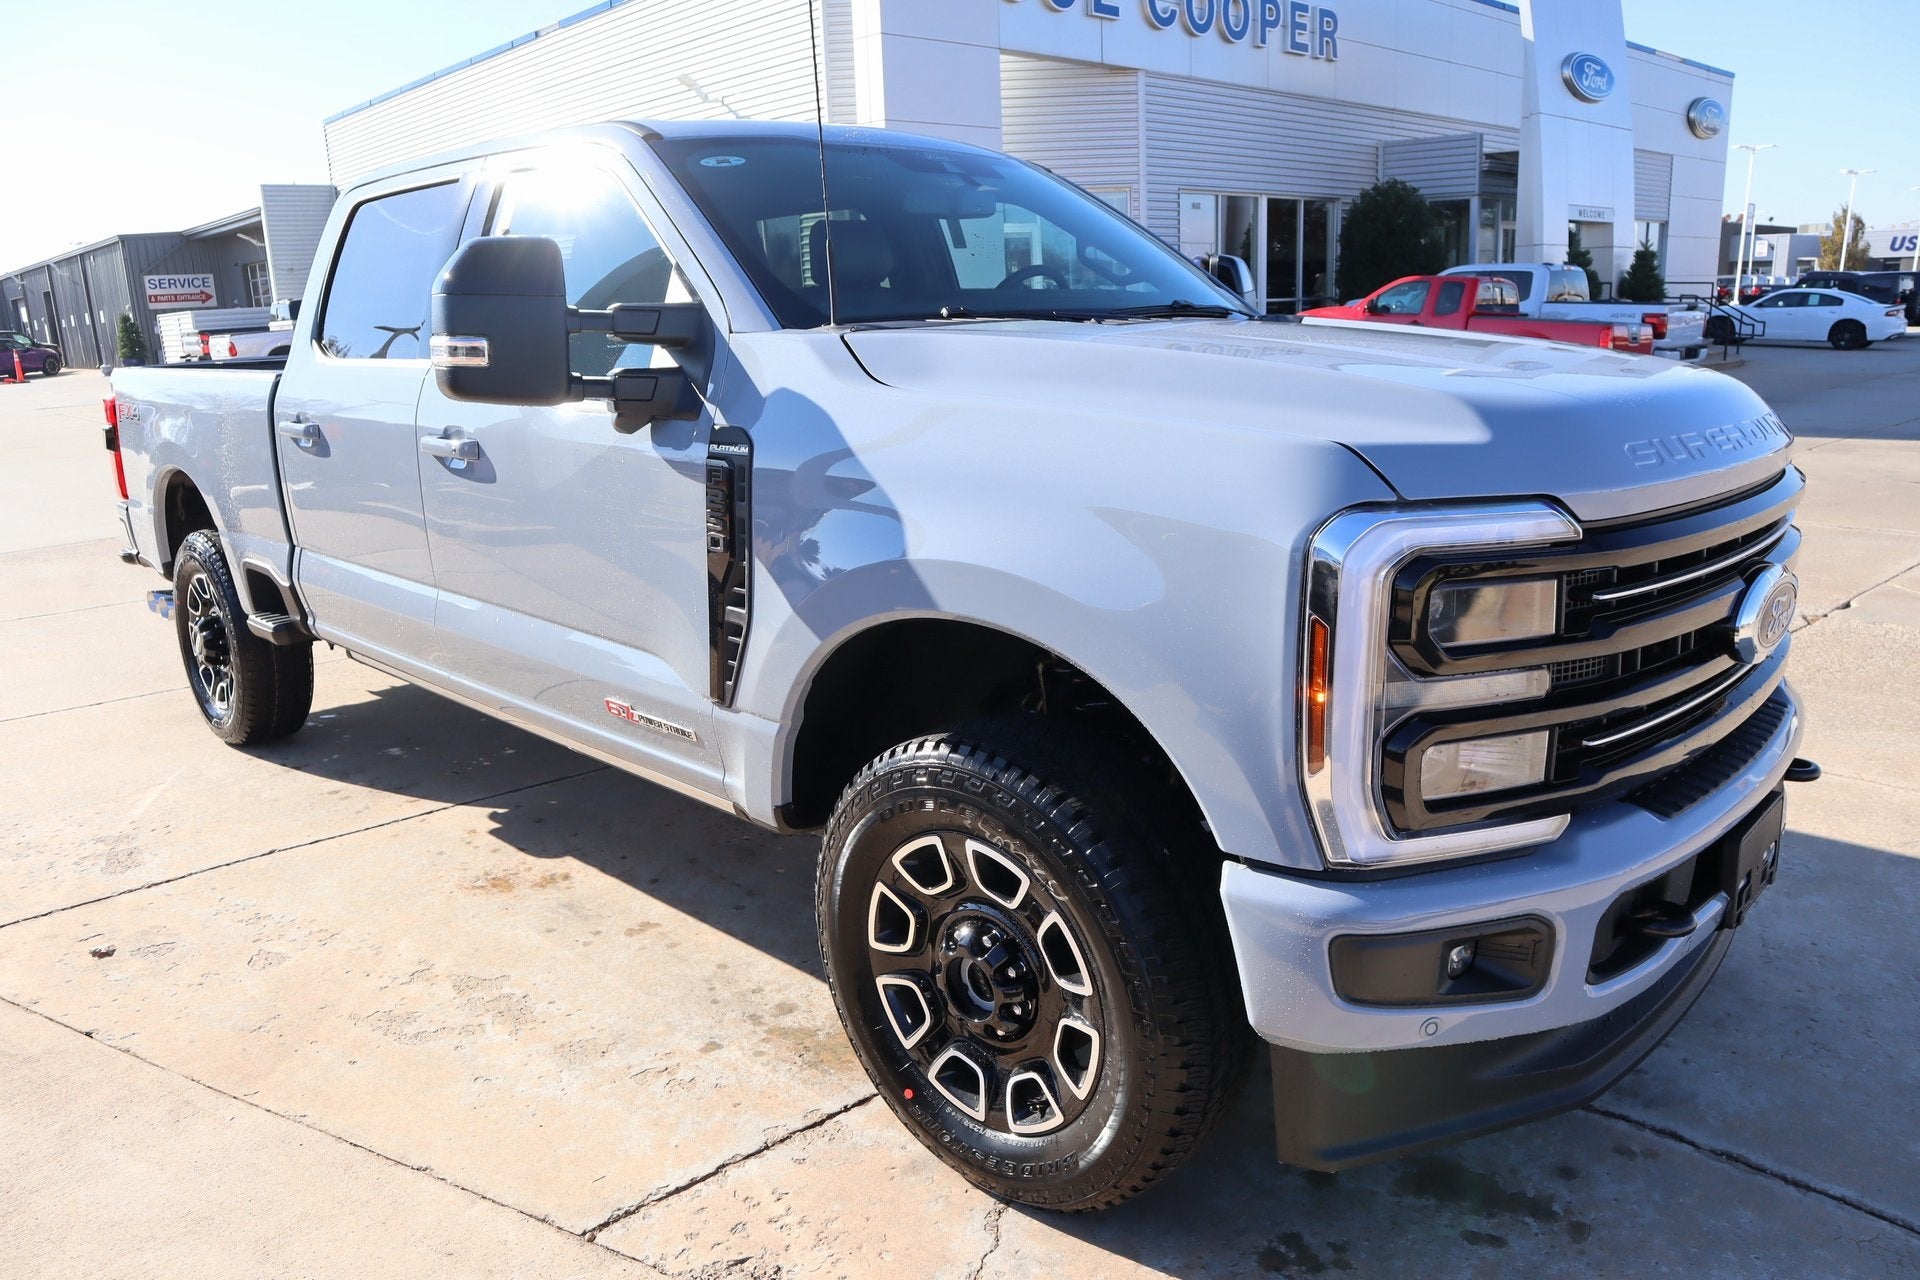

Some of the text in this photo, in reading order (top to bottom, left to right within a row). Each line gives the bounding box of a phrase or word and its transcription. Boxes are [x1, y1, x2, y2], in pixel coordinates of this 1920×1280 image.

[1144, 0, 1340, 61] COOPER
[1582, 61, 1608, 90] Ford
[1578, 209, 1605, 219] WELCOME
[147, 277, 212, 290] SERVICE
[156, 294, 176, 302] PARTS
[177, 293, 206, 301] ENTRANCE
[709, 443, 749, 453] PLATINUM
[1624, 424, 1753, 470] SUPER
[638, 714, 663, 729] POWER
[663, 722, 695, 741] STROKE
[909, 1104, 1079, 1178] BRIDGESTONE
